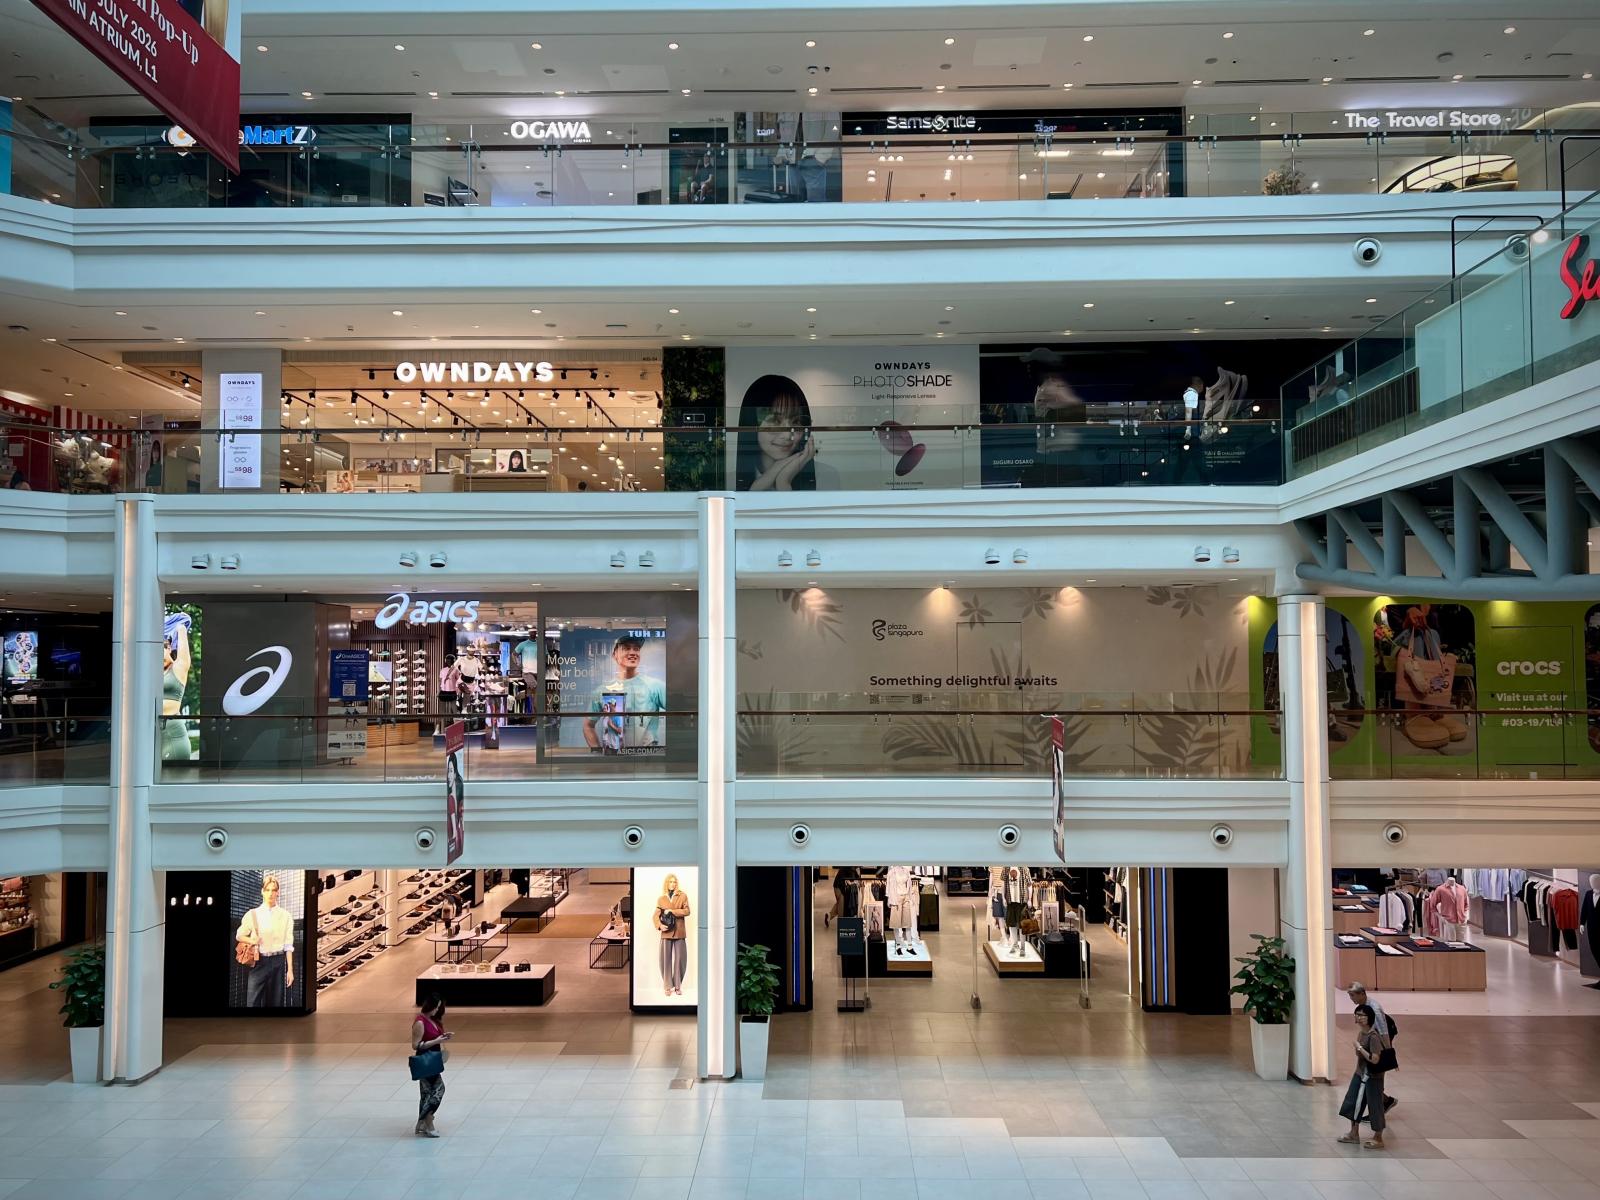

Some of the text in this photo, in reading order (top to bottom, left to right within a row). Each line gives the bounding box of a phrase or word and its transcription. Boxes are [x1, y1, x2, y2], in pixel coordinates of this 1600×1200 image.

[68, 0, 158, 83] IN ATRIUM, L1
[130, 20, 157, 57] 2026
[886, 114, 976, 131] Samsonite
[1345, 110, 1502, 128] The Travel Store
[238, 125, 308, 144] eMartZ
[510, 120, 592, 139] OGAWA
[395, 361, 554, 383] OWNDAYS
[874, 362, 932, 370] OWNDAYS
[853, 375, 953, 387] PHOTOSHADE
[887, 622, 908, 630] plaza
[547, 654, 577, 665] Move
[1496, 661, 1561, 675] crocs
[547, 681, 577, 690] move
[869, 675, 1058, 688] Something delightful awaits
[1496, 693, 1568, 701] Visit us at our
[170, 893, 213, 906] edro
